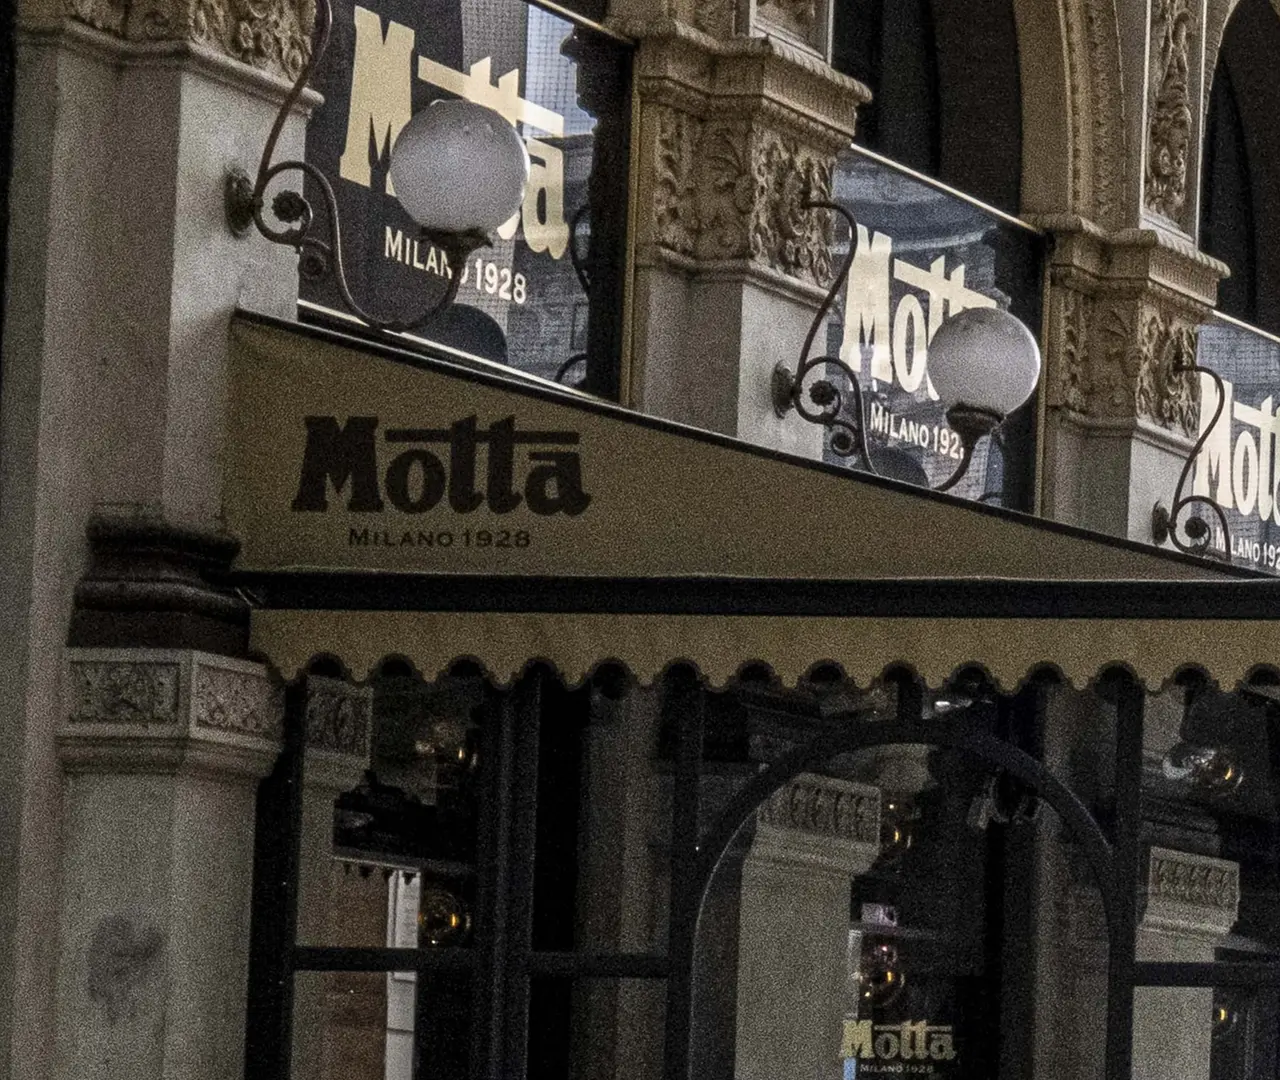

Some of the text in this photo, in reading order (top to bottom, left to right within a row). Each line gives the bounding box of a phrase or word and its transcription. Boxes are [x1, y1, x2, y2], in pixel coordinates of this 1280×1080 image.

[384, 225, 527, 304] MILAN 1928
[870, 402, 964, 460] MILANO 192
[291, 414, 592, 517] Motta
[350, 528, 531, 549] MILANO 1928
[1216, 527, 1260, 562] MLANO
[839, 1020, 957, 1060] Motta
